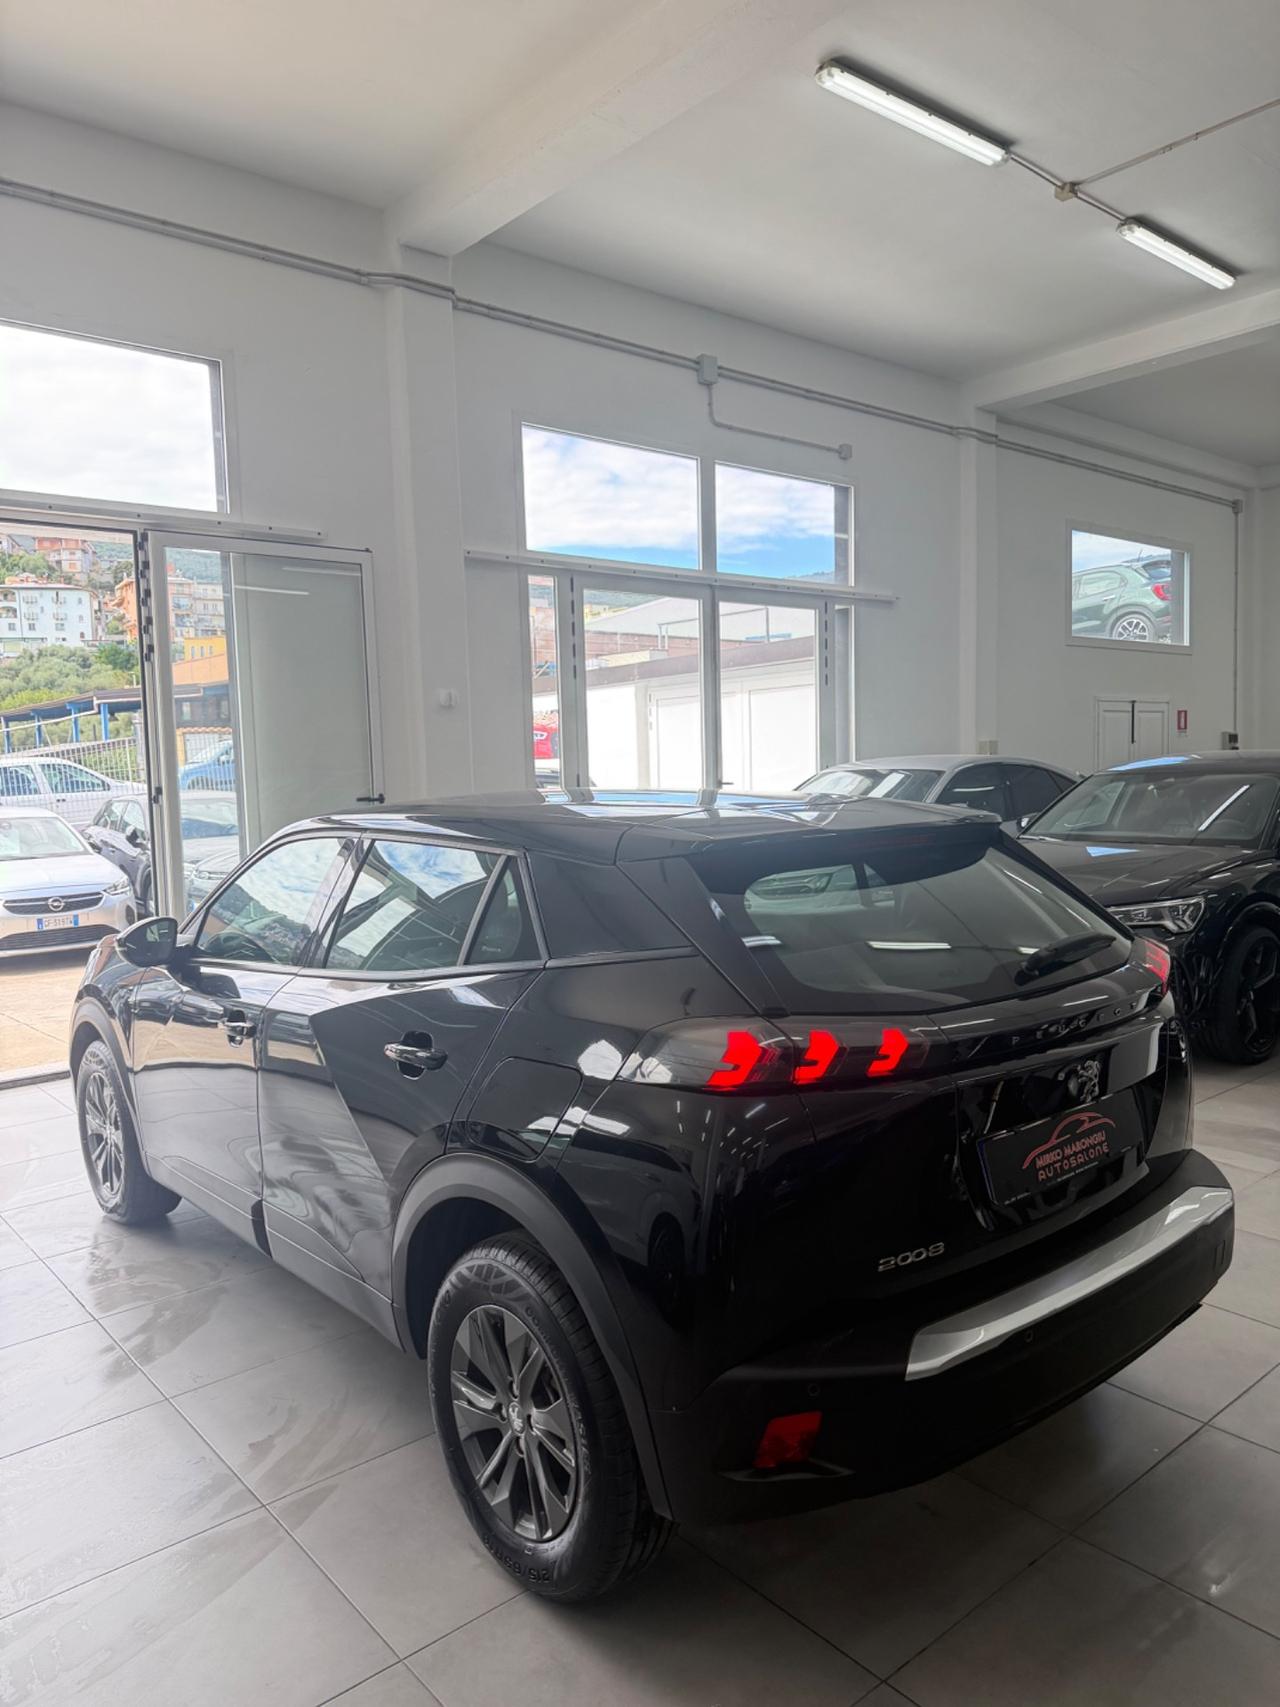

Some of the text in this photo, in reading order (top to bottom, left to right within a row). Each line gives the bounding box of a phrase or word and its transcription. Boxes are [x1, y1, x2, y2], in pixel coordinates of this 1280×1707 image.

[1036, 1130, 1107, 1169] MIRKO MARONGIU
[1038, 1142, 1110, 1182] AUTOSALONE
[877, 1242, 945, 1272] 2008
